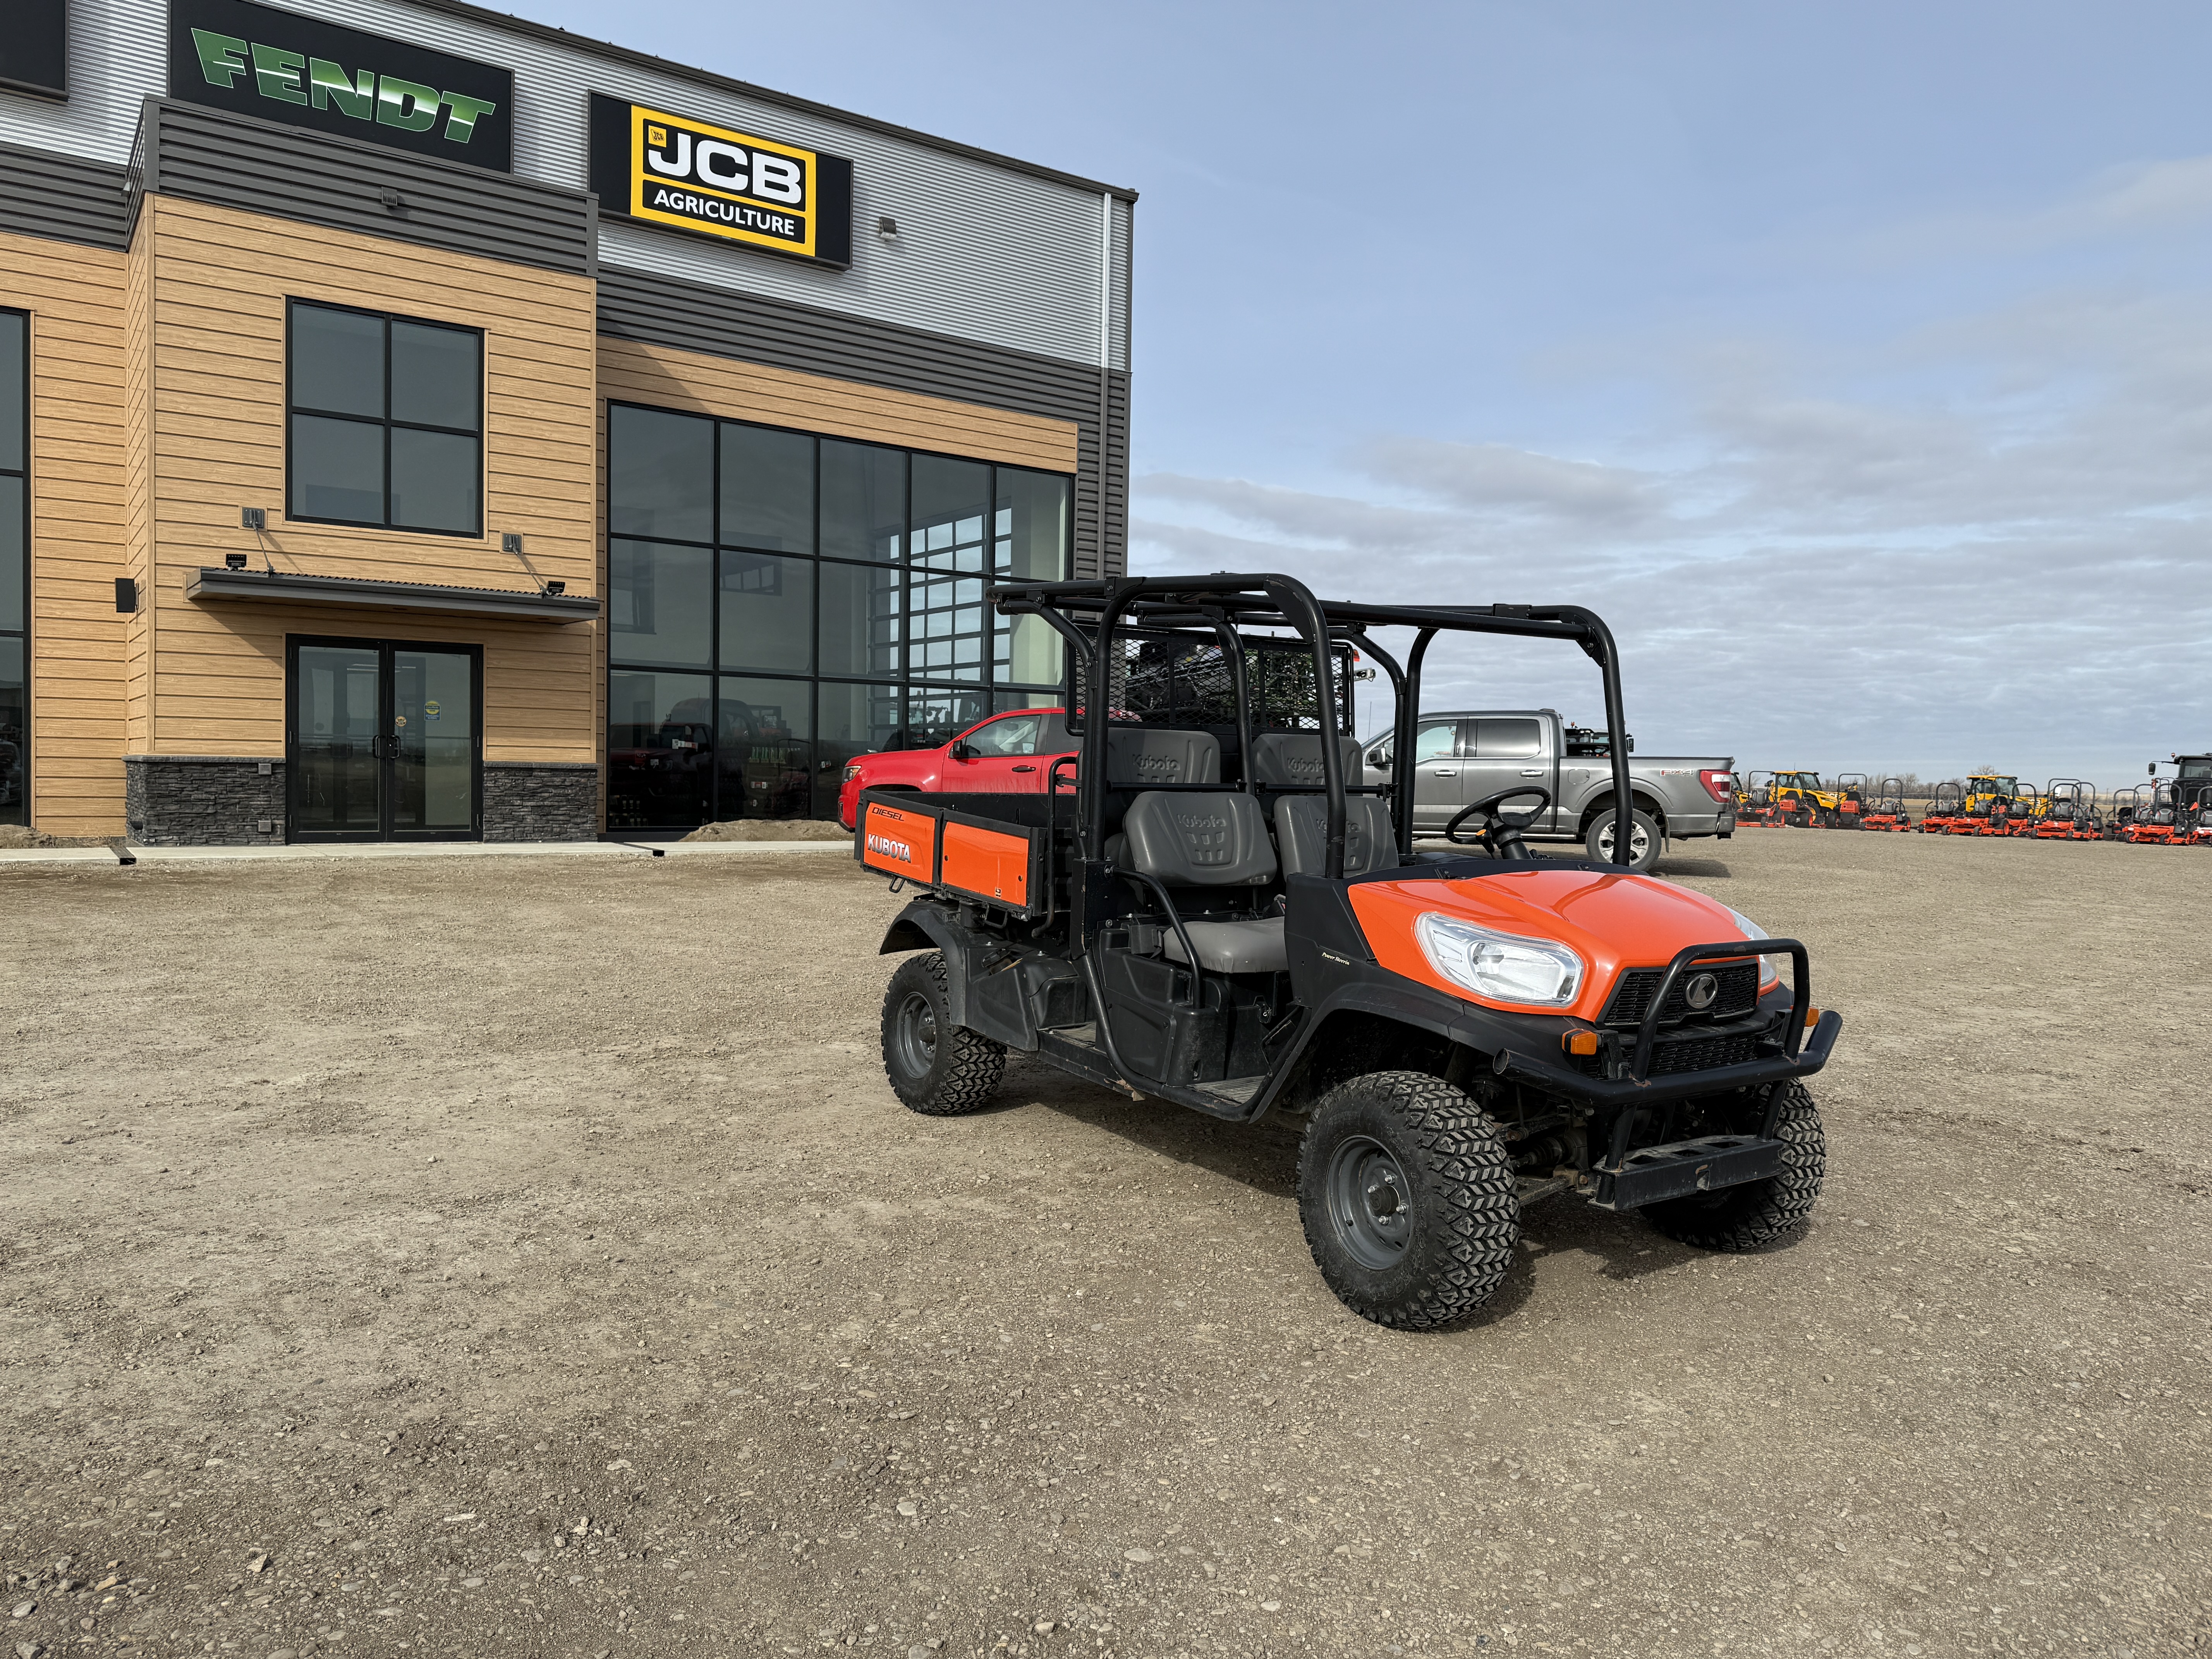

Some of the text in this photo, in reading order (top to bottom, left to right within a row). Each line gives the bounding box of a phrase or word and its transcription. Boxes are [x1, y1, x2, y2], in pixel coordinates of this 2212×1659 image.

[191, 28, 496, 144] FENDT
[653, 131, 664, 140] JCB
[648, 133, 802, 204] JCB
[654, 189, 795, 236] AGRICULTURE
[1132, 754, 1180, 770] Kubota
[872, 807, 905, 821] DIESEL
[1177, 814, 1226, 827] Kubota
[867, 833, 911, 864] KUBOTA
[1322, 952, 1336, 960] Power
